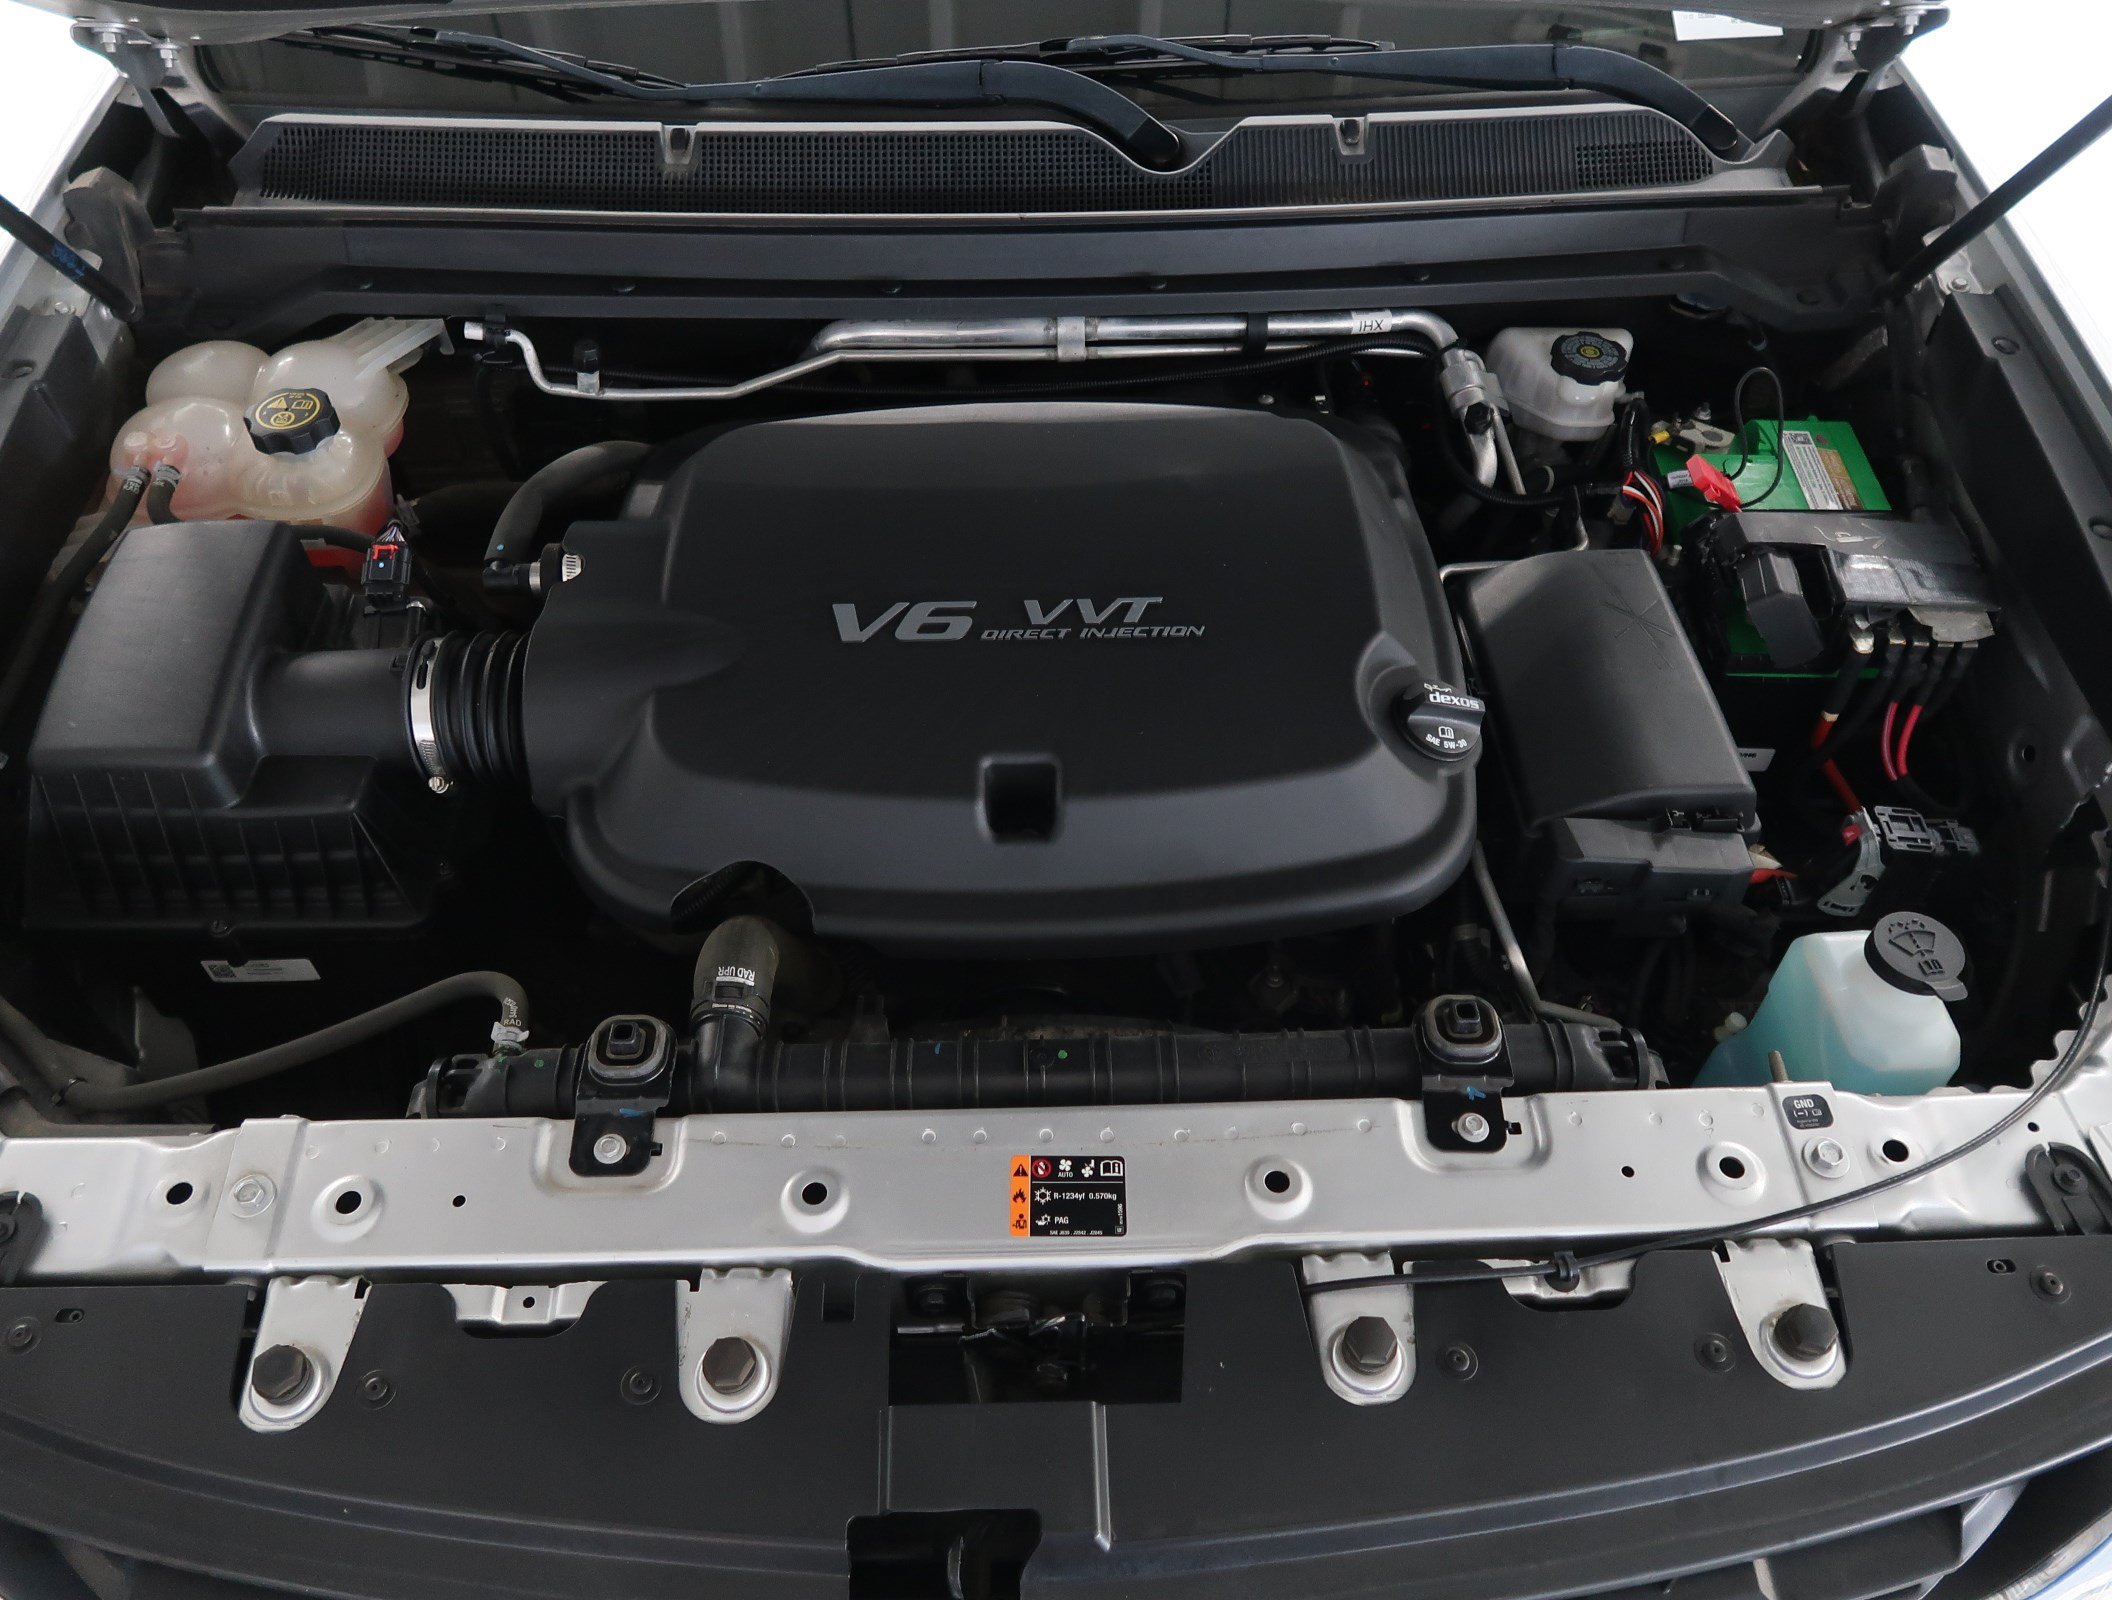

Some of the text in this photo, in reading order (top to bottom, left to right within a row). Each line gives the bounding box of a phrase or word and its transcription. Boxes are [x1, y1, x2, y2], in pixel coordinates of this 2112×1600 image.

[1359, 320, 1383, 331] IHX
[1023, 596, 1163, 625] VVT
[832, 600, 977, 642] V6
[980, 625, 1205, 641] DIRECT INJECTION
[1429, 691, 1480, 710] dexos
[1425, 733, 1467, 749] SAE 5W-30
[718, 966, 755, 981] RAD UPR
[1793, 1098, 1814, 1108] GND
[1053, 1192, 1117, 1201] R-1234yf 0.570kg
[1054, 1216, 1069, 1224] PAG
